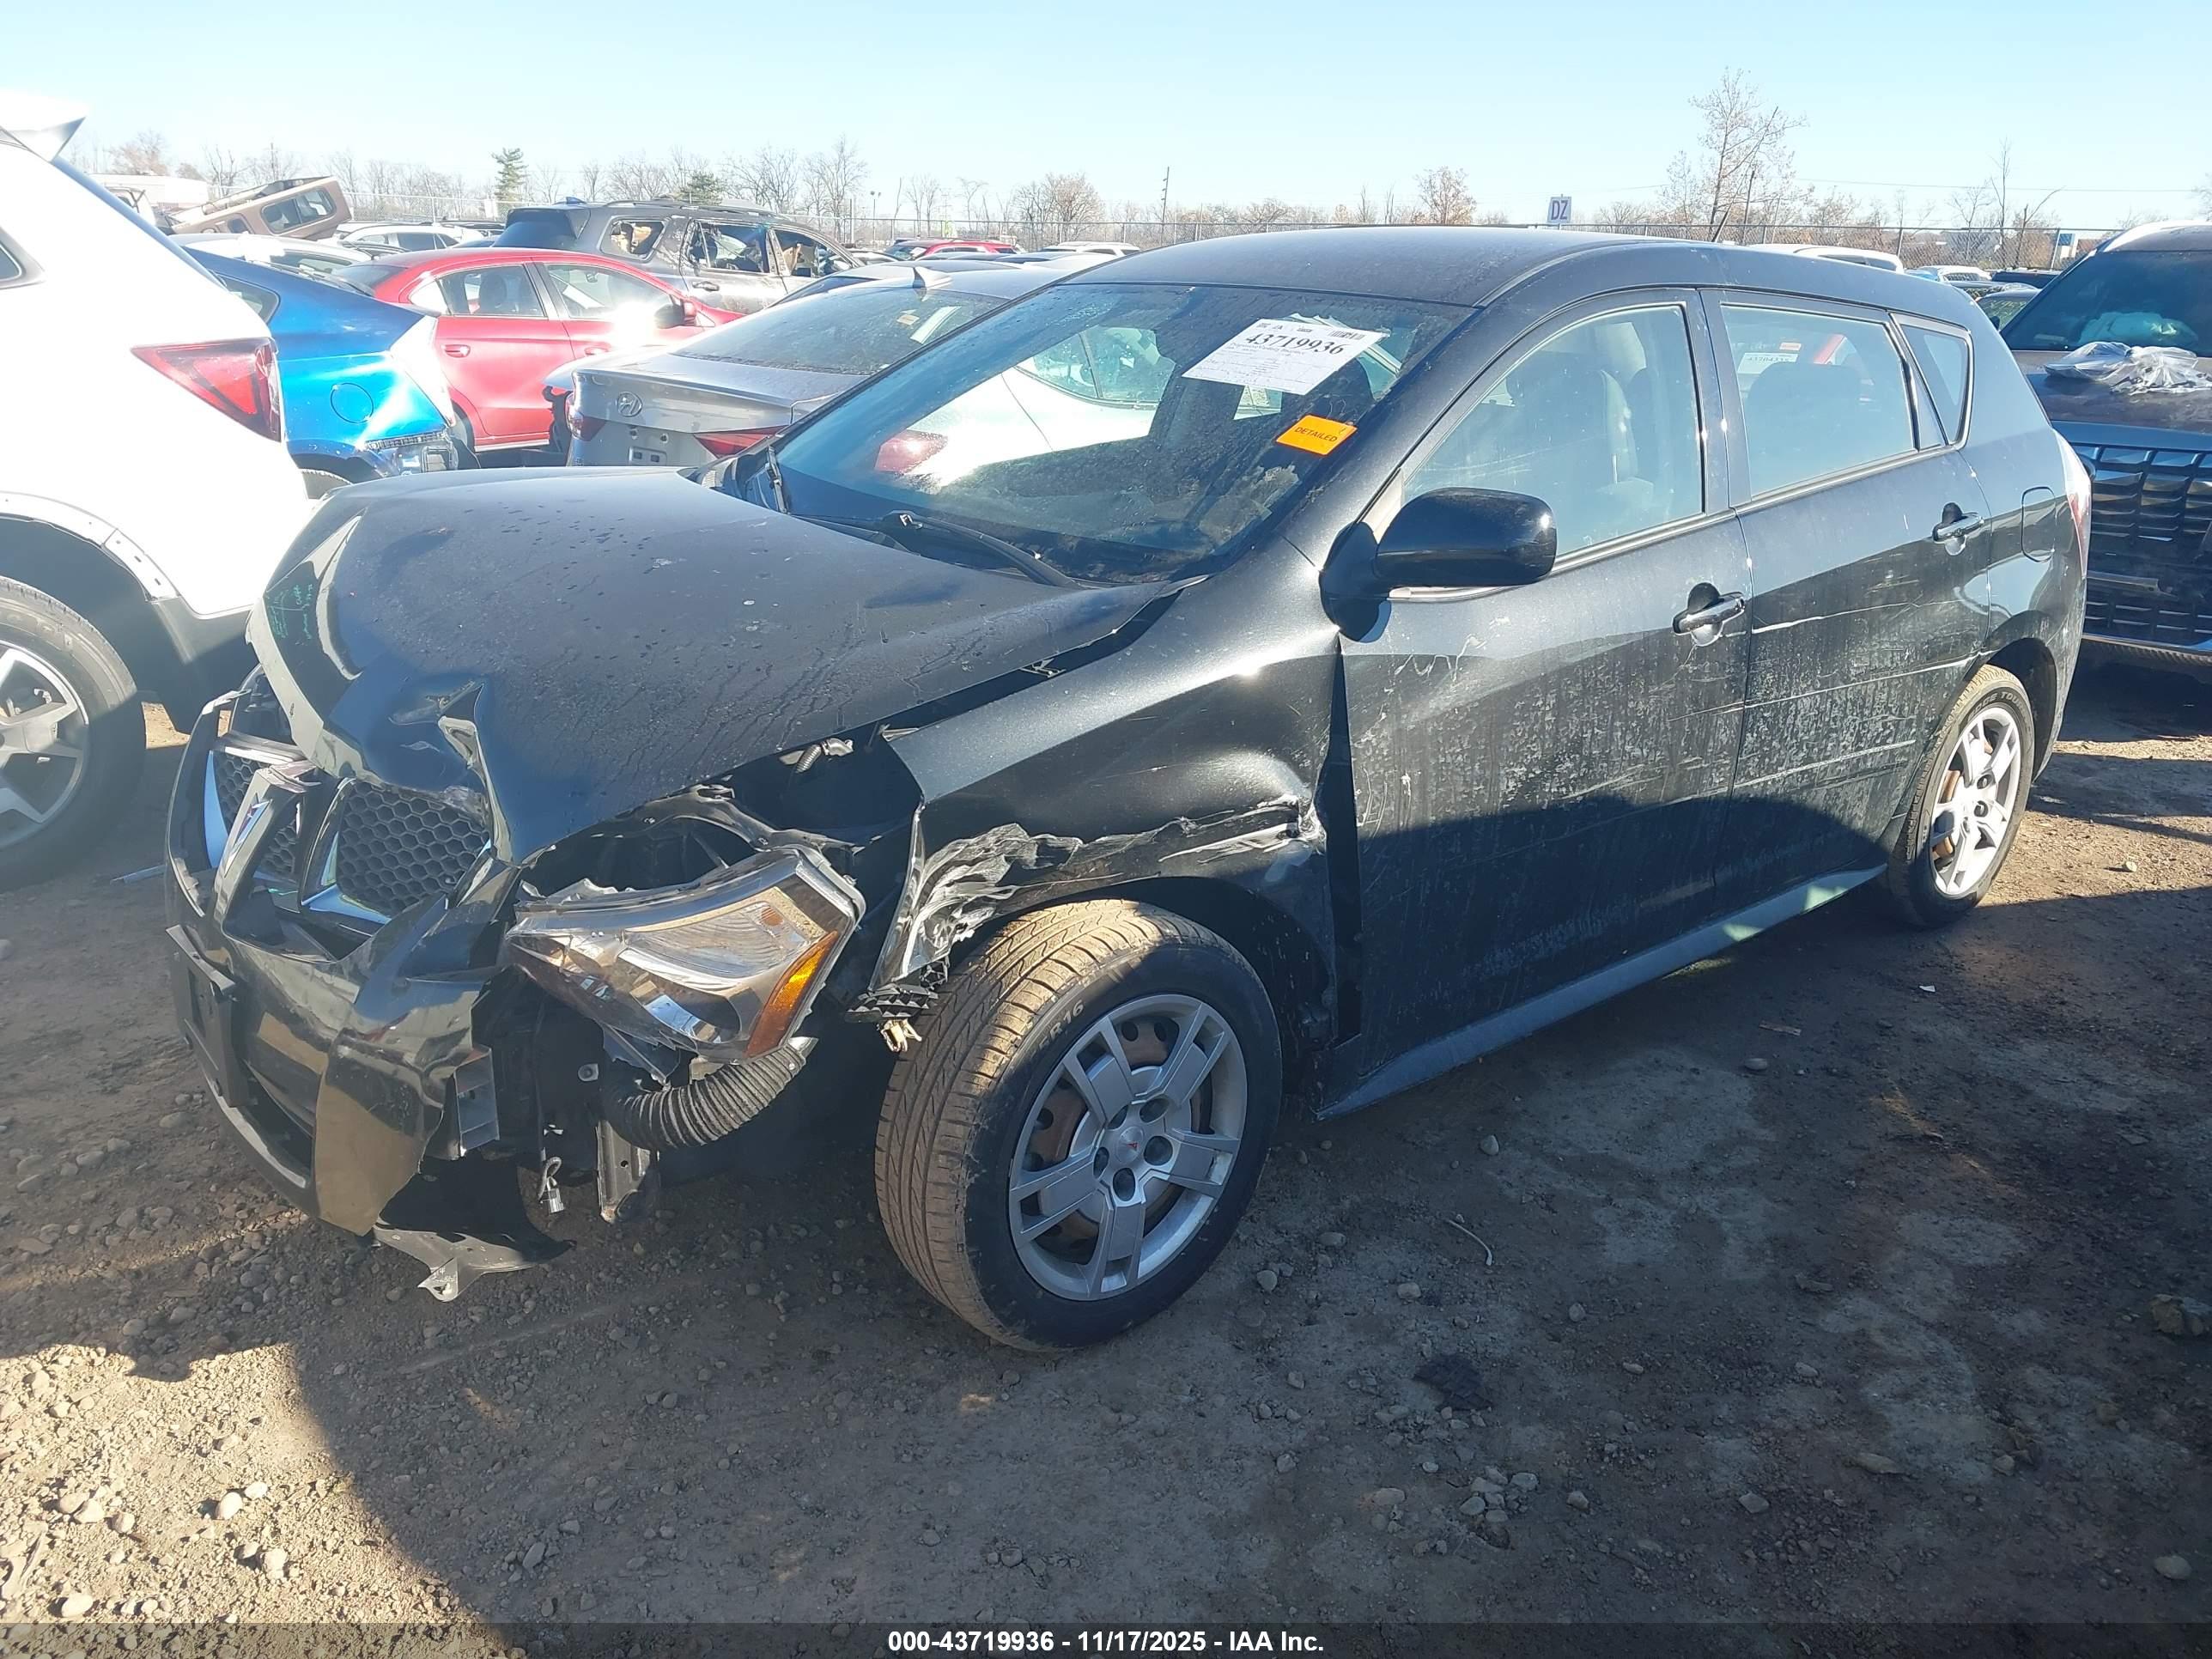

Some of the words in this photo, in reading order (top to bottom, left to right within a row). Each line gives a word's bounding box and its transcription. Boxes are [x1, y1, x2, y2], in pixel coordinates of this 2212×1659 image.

[1551, 199, 1568, 221] DZ
[1245, 332, 1351, 356] 43719936
[1294, 427, 1338, 442] DETAILED
